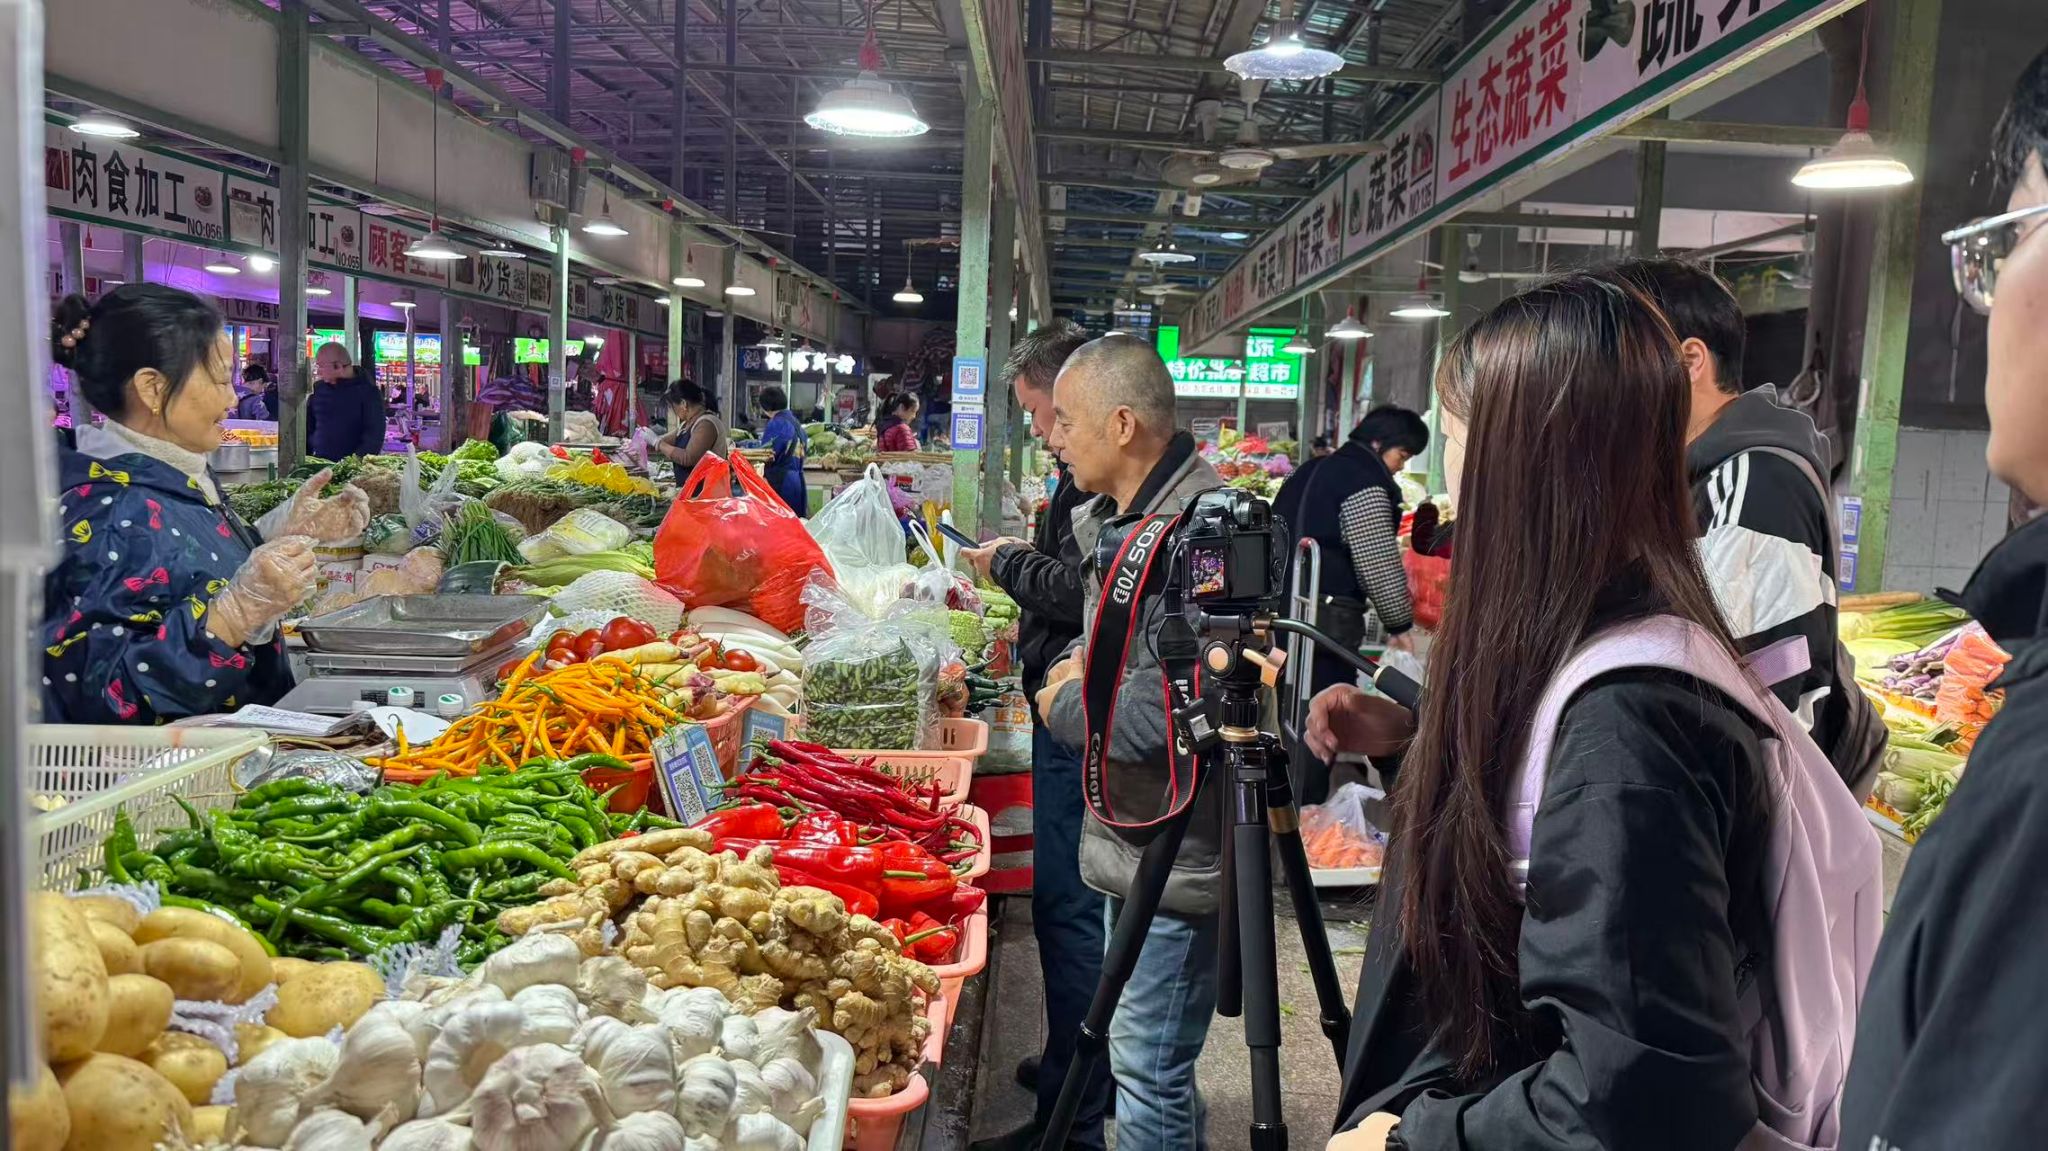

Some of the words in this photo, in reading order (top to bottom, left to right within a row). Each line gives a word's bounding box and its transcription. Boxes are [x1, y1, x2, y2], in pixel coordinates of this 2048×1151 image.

[1448, 0, 1569, 182] 生态蔬菜
[71, 141, 188, 224] 肉食加工
[1366, 132, 1411, 236] 蔬菜
[187, 218, 223, 240] NO:056
[257, 191, 335, 254] 肉工
[478, 255, 512, 299] 炒货
[1128, 521, 1165, 563] EOS
[1113, 566, 1138, 604] 70D
[1089, 732, 1102, 807] Canon
